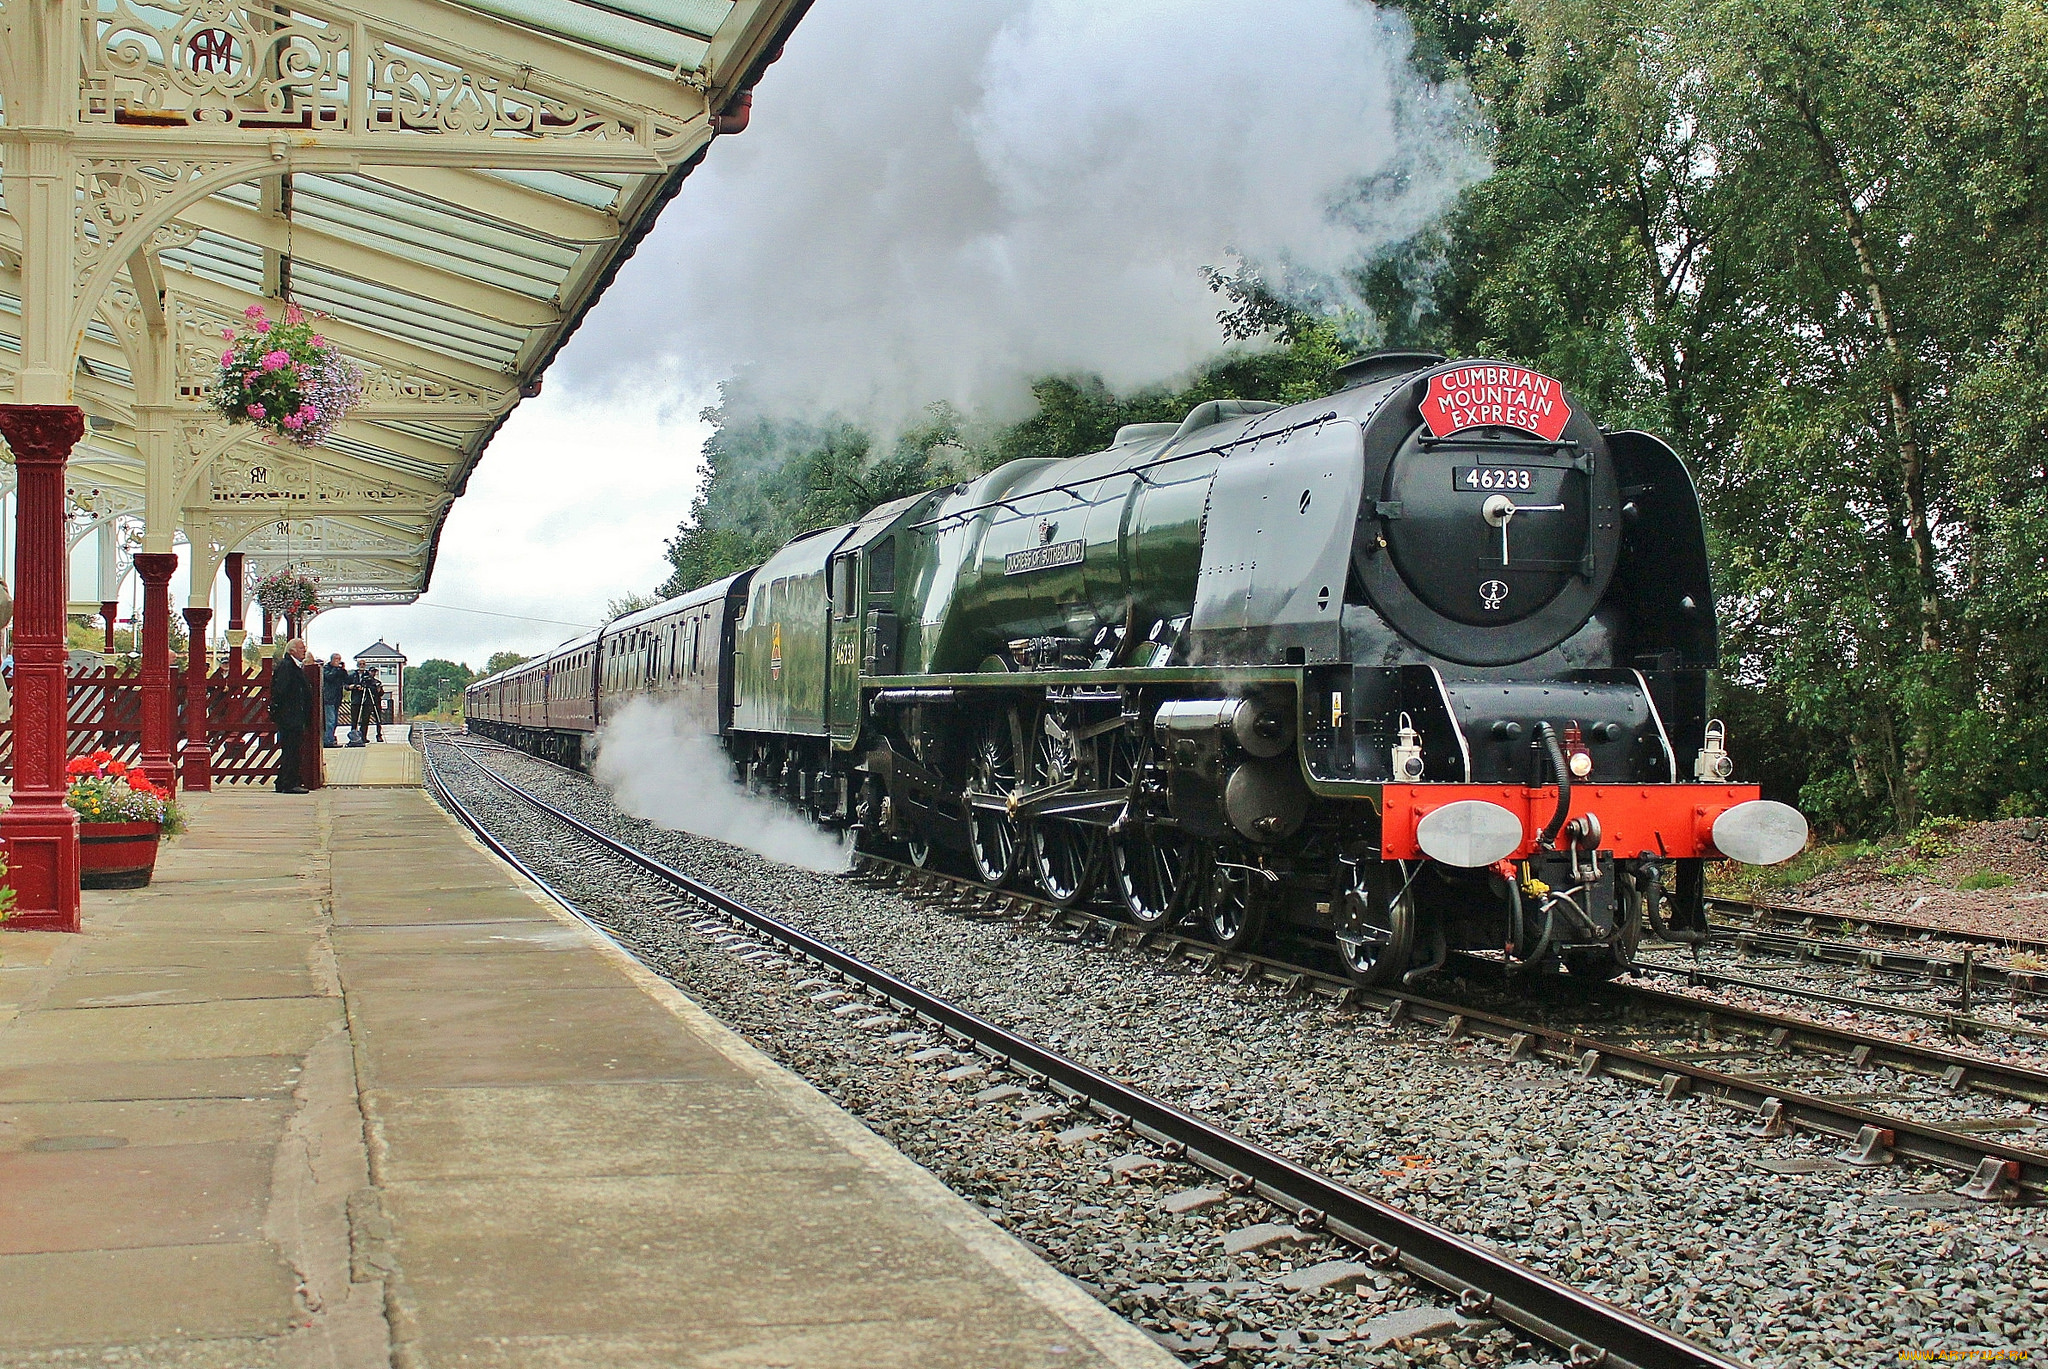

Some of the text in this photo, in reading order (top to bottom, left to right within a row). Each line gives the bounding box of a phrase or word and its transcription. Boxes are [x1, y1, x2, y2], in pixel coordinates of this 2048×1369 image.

[1441, 368, 1551, 396] CUMBRIAN
[1437, 387, 1553, 416] MOUNTAIN
[1451, 406, 1540, 430] EXPRESS
[1466, 469, 1530, 489] 46233
[1032, 549, 1042, 566] OF
[1484, 600, 1501, 610] SC
[836, 642, 855, 664] 46233
